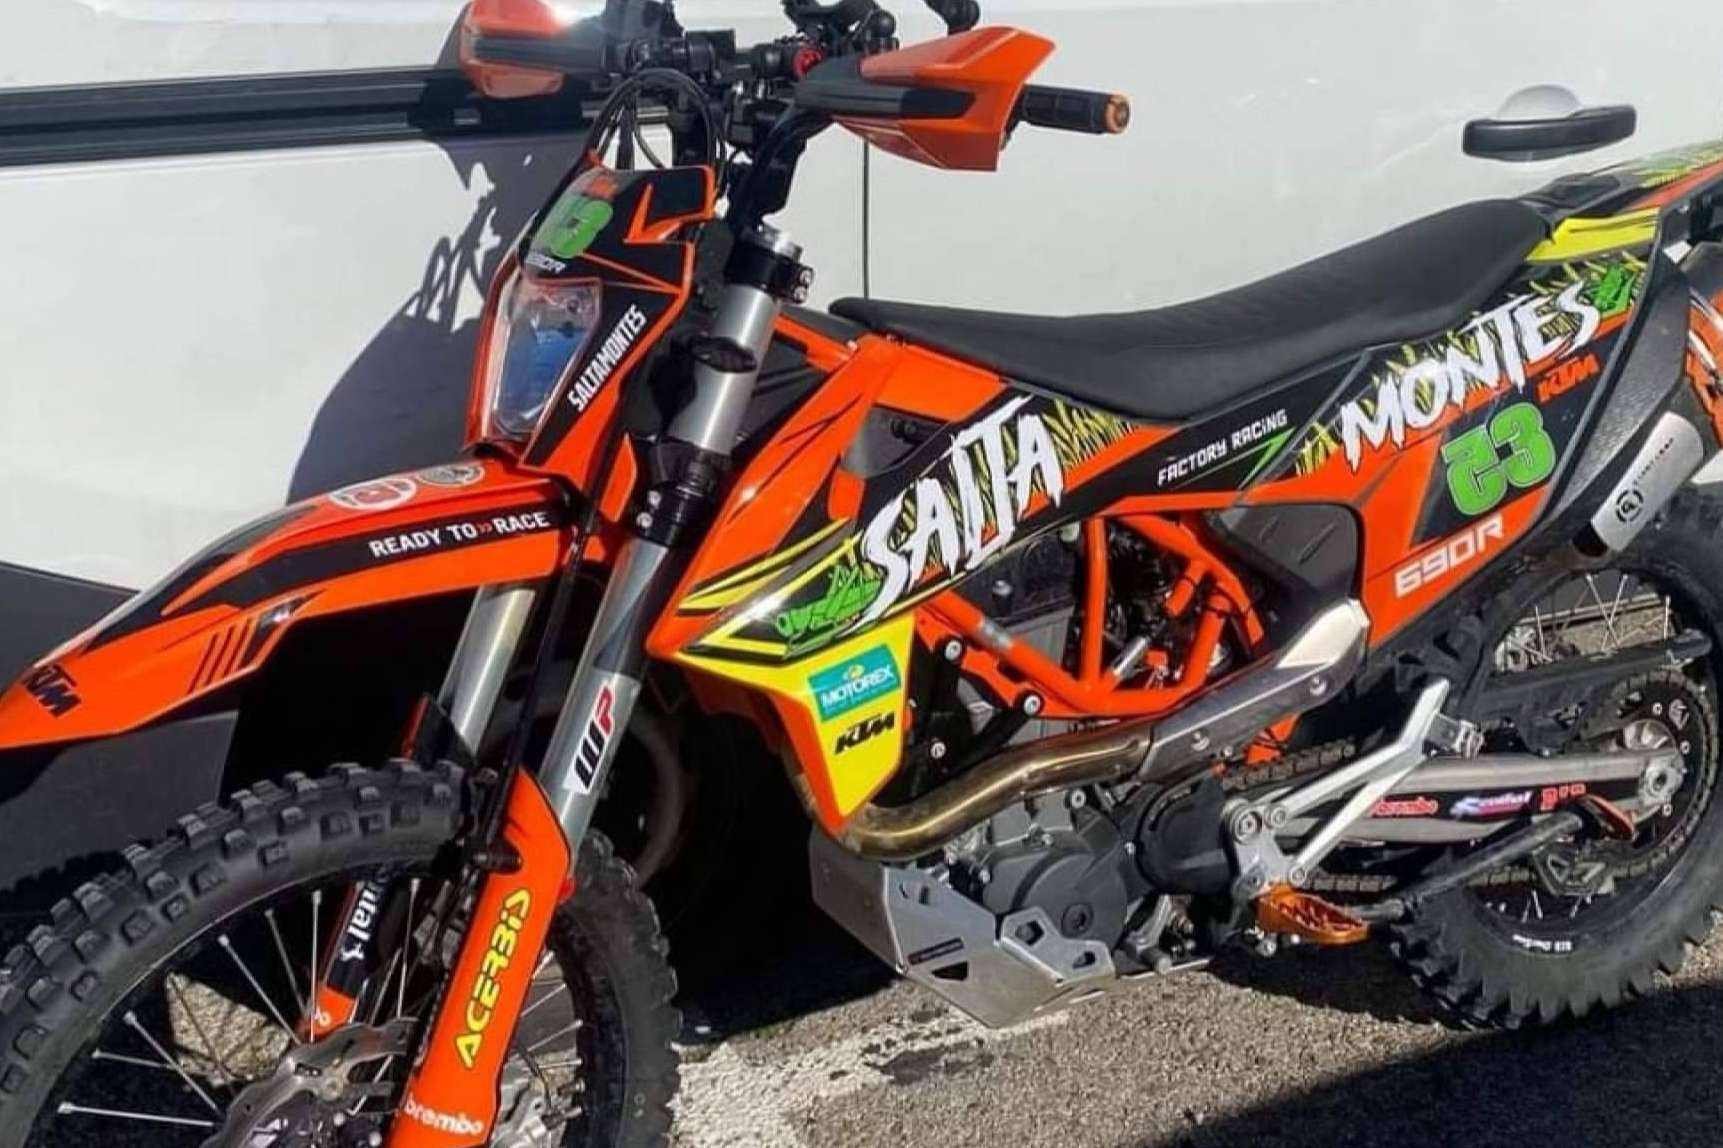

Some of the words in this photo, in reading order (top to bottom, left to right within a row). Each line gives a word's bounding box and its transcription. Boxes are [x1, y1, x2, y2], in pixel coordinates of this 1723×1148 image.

[567, 304, 647, 412] SALTAMONTES
[1341, 281, 1600, 474] MONTES
[1536, 353, 1600, 403] KTM
[1157, 438, 1228, 487] FACTORY
[368, 527, 441, 557] READY
[446, 523, 478, 542] TO
[492, 511, 551, 534] RACE
[838, 394, 1064, 637] SALTA
[1395, 517, 1504, 598] 690R
[820, 664, 894, 706] MOTOREX
[835, 712, 896, 755] KTM
[404, 1093, 484, 1136] brembo
